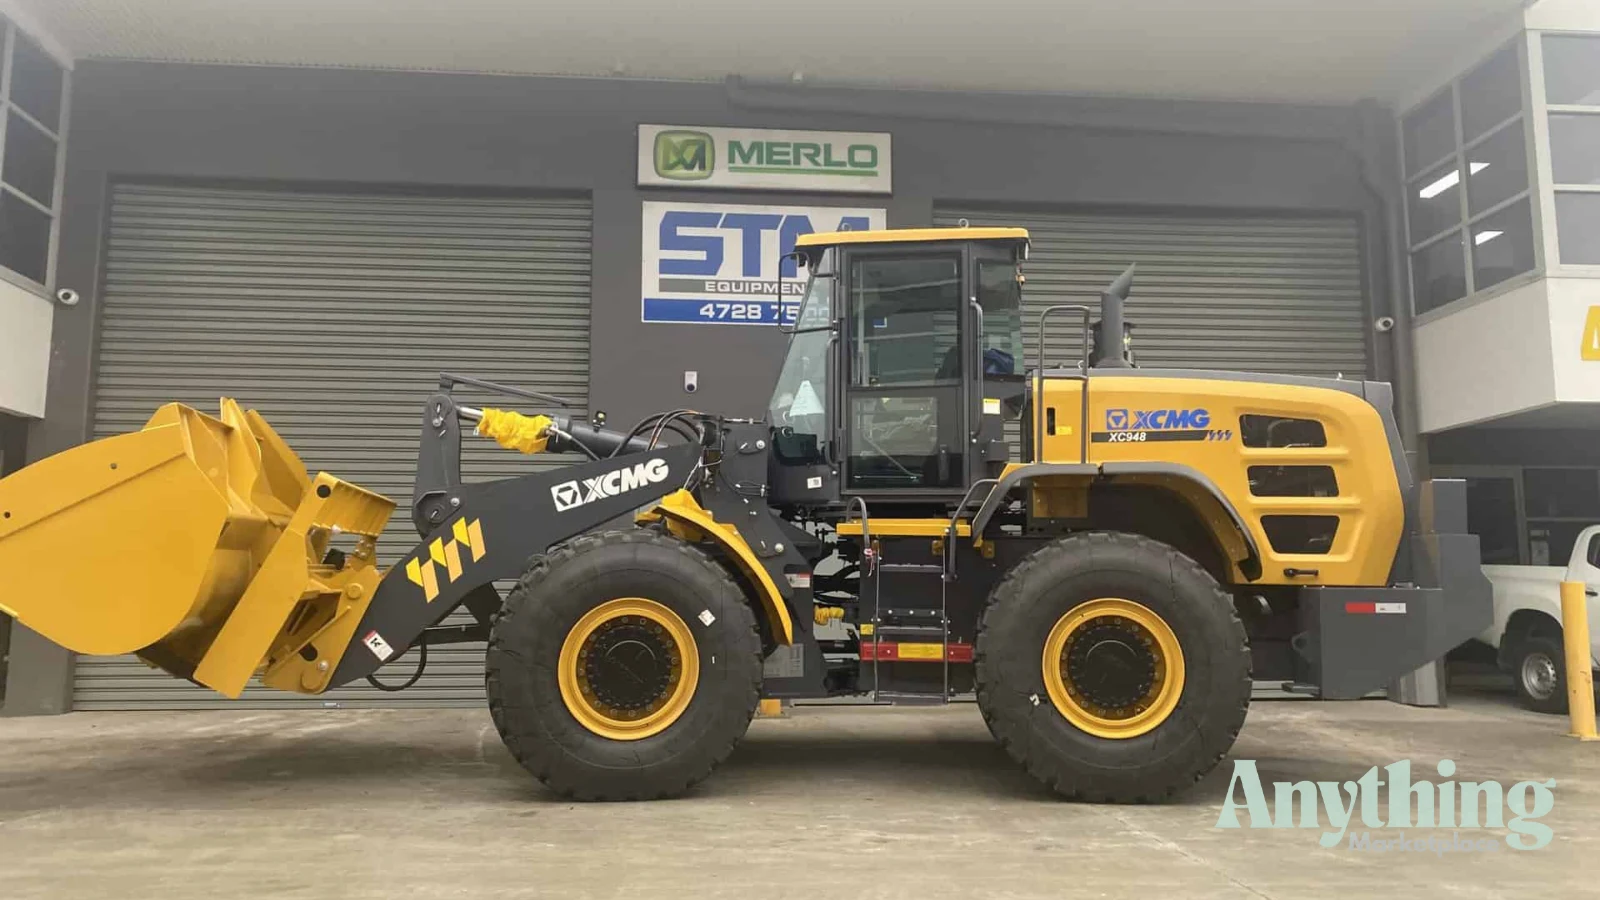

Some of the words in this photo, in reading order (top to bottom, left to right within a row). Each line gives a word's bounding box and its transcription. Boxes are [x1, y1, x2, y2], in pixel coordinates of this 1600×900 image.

[728, 140, 878, 168] MERLO
[704, 281, 806, 295] EQUIPMEN
[699, 302, 762, 320] 4728
[1130, 408, 1210, 430] XCMG
[1108, 432, 1147, 442] XC948
[582, 458, 669, 504] XCMG
